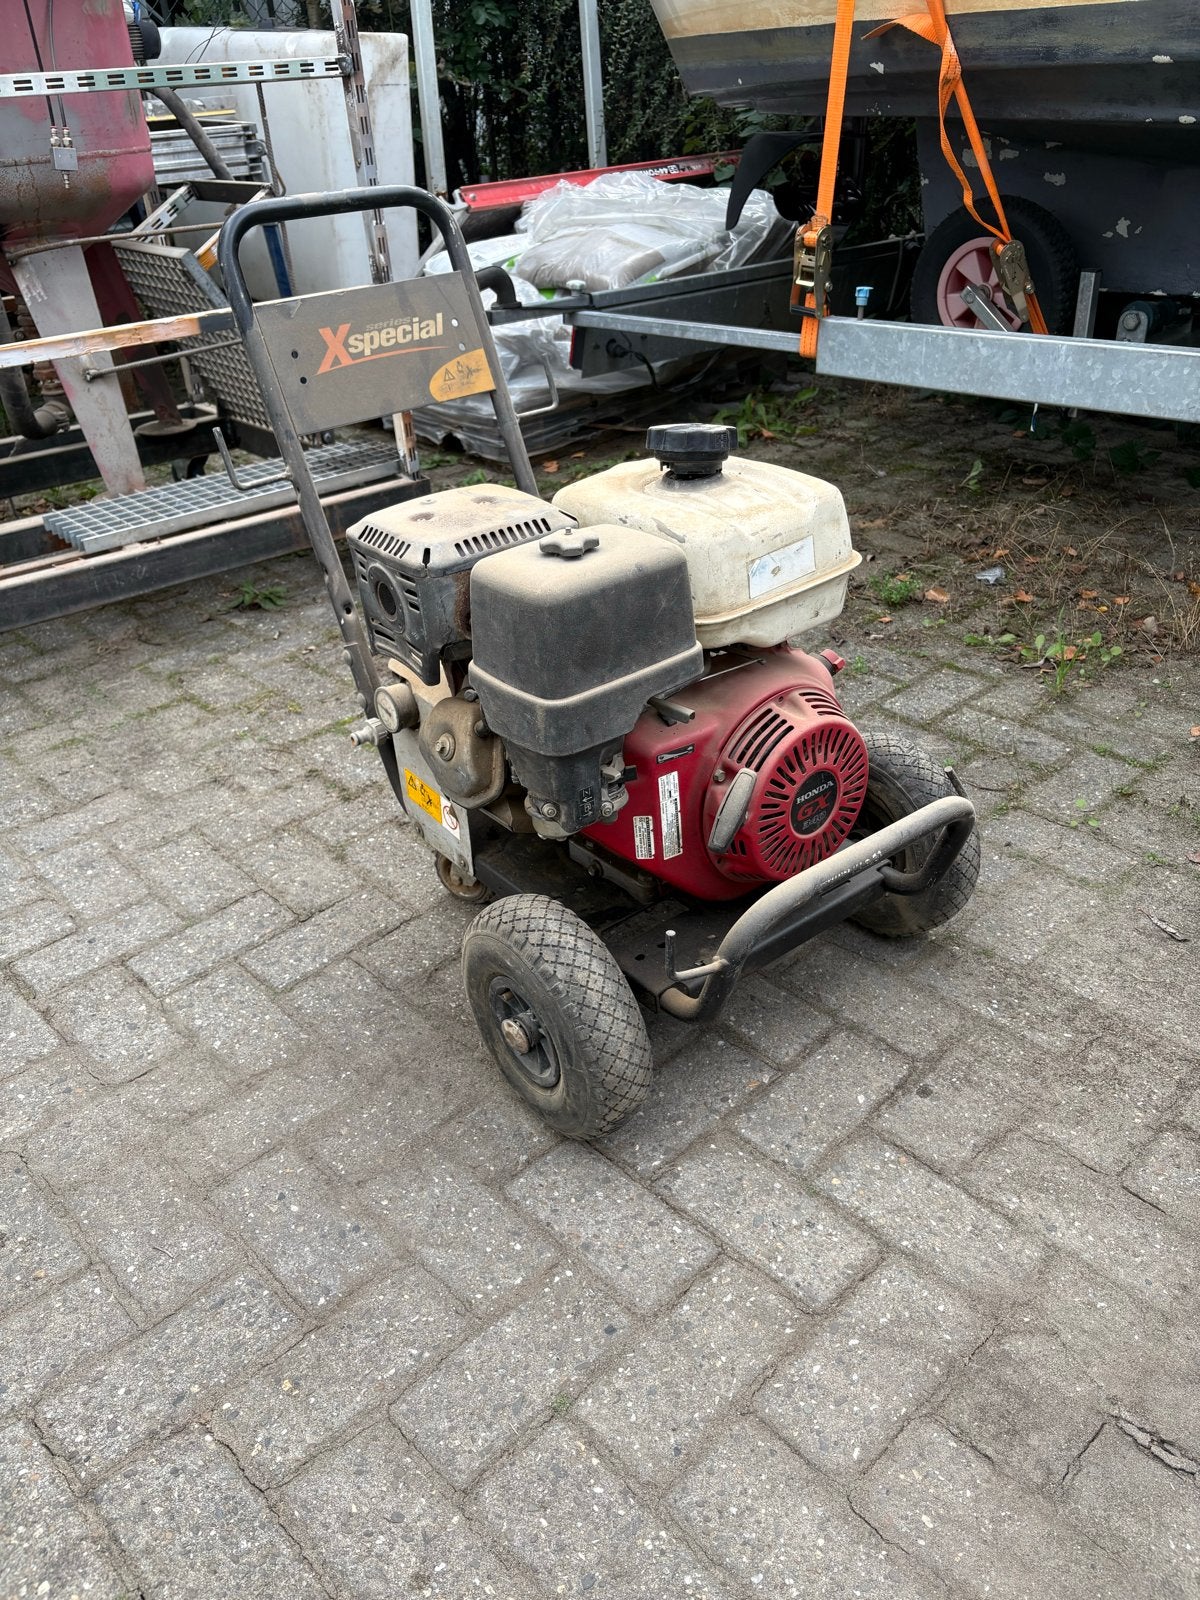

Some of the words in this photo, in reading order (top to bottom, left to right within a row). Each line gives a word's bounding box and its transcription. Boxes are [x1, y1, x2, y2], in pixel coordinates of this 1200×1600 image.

[365, 316, 412, 331] series
[796, 780, 835, 804] HONDA
[797, 791, 833, 821] GX
